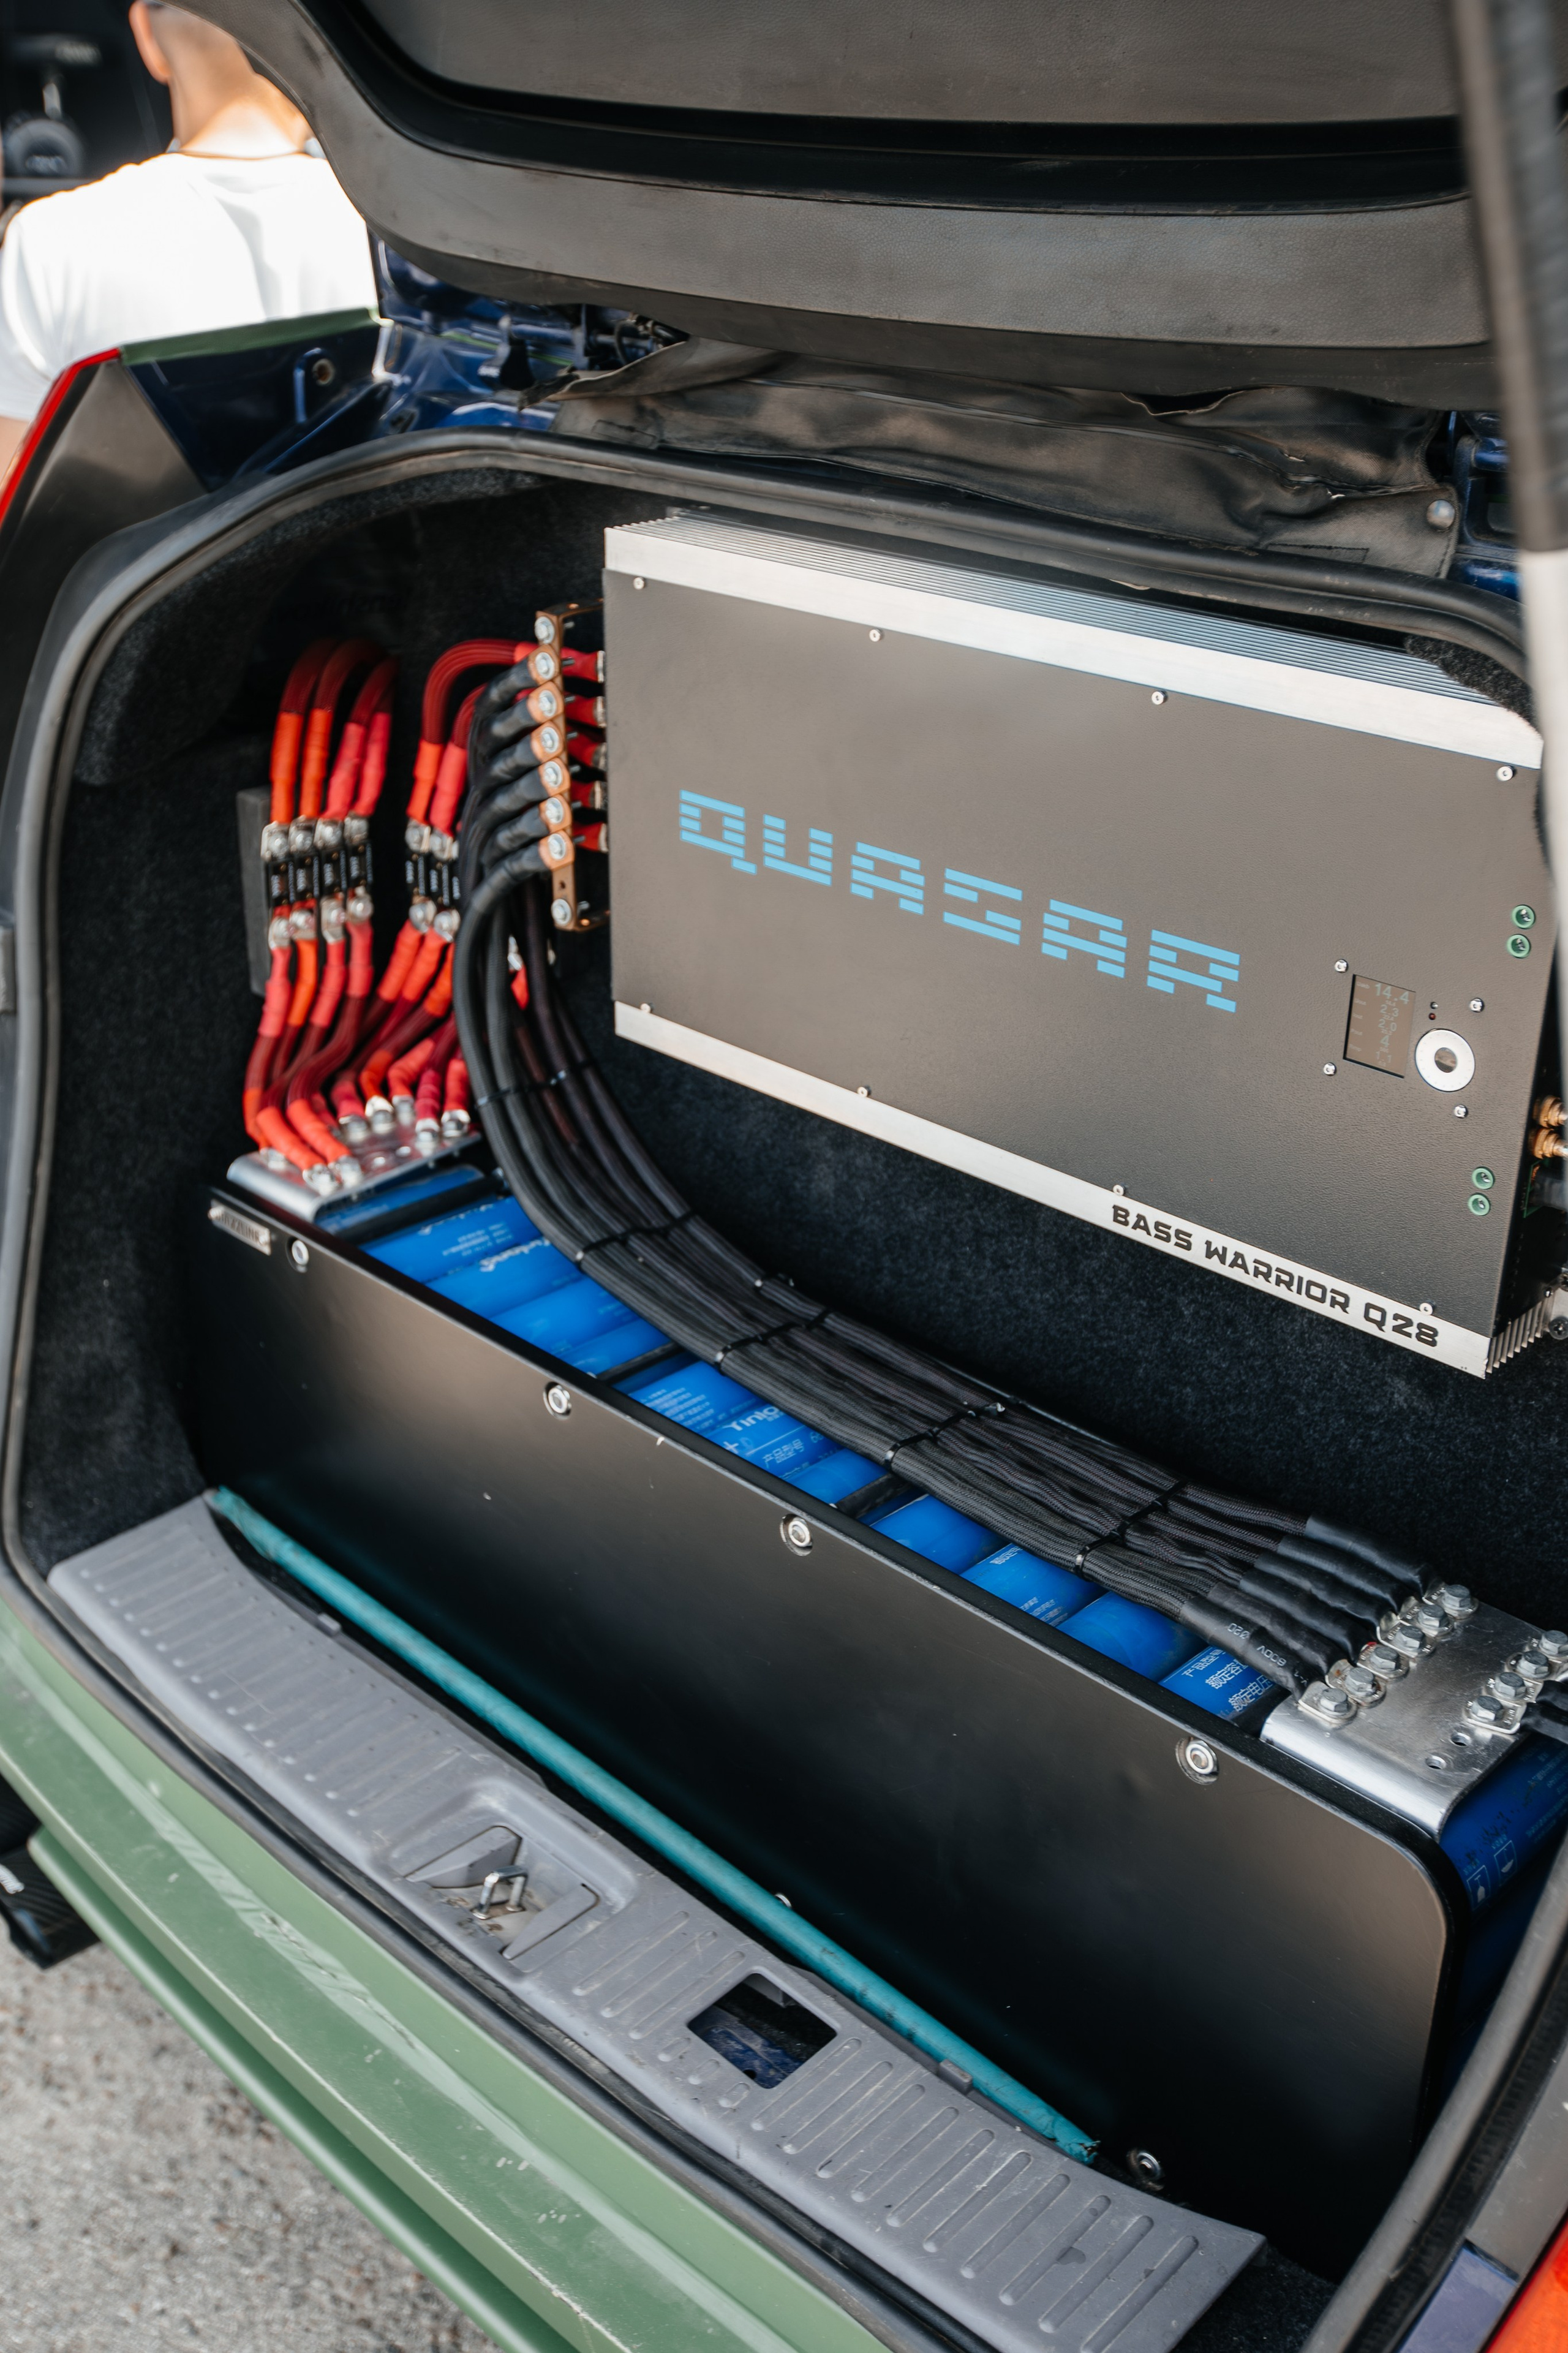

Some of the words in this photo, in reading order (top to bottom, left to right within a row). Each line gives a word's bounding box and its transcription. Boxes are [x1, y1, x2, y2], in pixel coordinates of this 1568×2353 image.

[679, 788, 1240, 1013] QUASAR
[1375, 983, 1409, 1005] 14.4
[1112, 1205, 1193, 1251] BASS
[1205, 1241, 1350, 1314] WARRIOR
[1364, 1302, 1439, 1347] Q28
[1256, 1644, 1287, 1667] 600V
